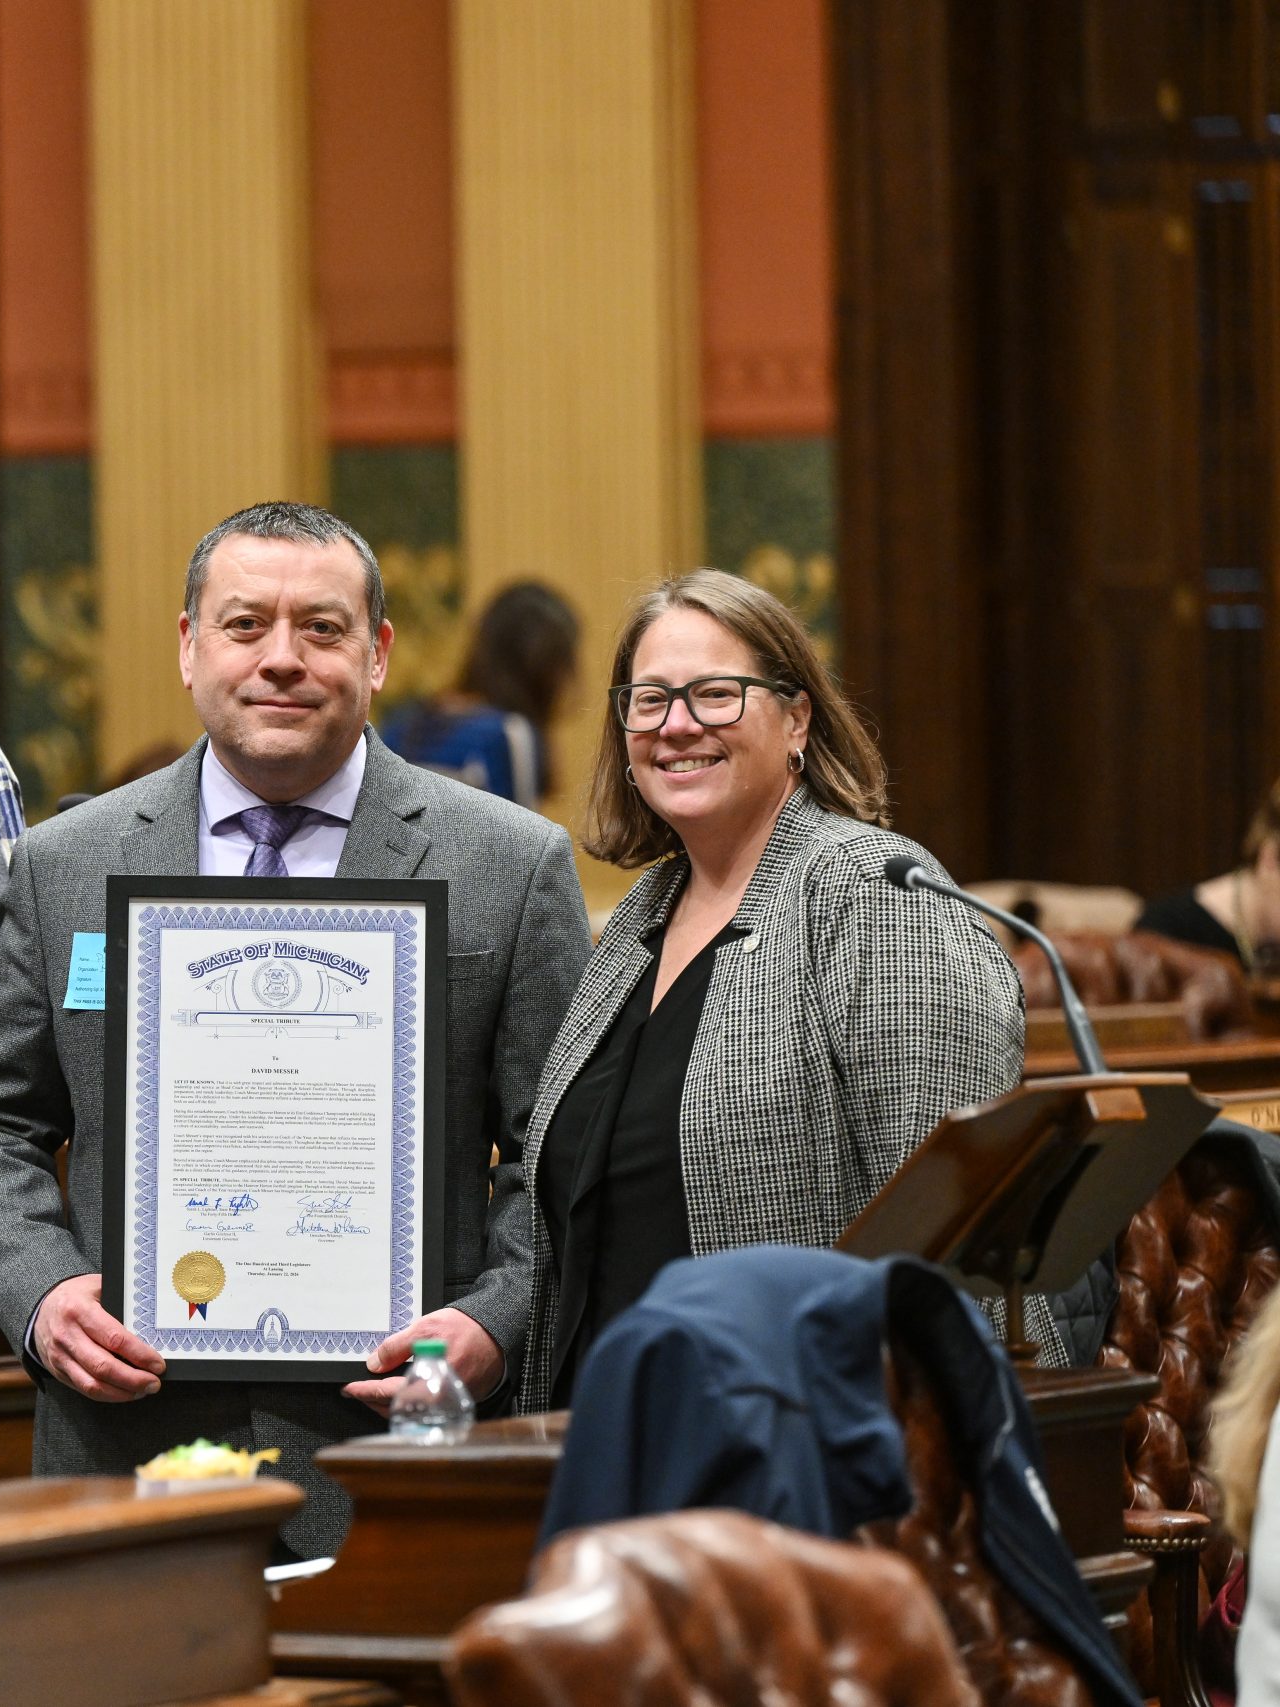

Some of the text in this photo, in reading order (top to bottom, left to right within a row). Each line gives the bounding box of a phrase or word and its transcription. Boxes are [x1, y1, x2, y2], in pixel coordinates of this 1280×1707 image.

[187, 949, 244, 979] STATE
[244, 942, 271, 960] OF
[1251, 1104, 1280, 1126] O'N
